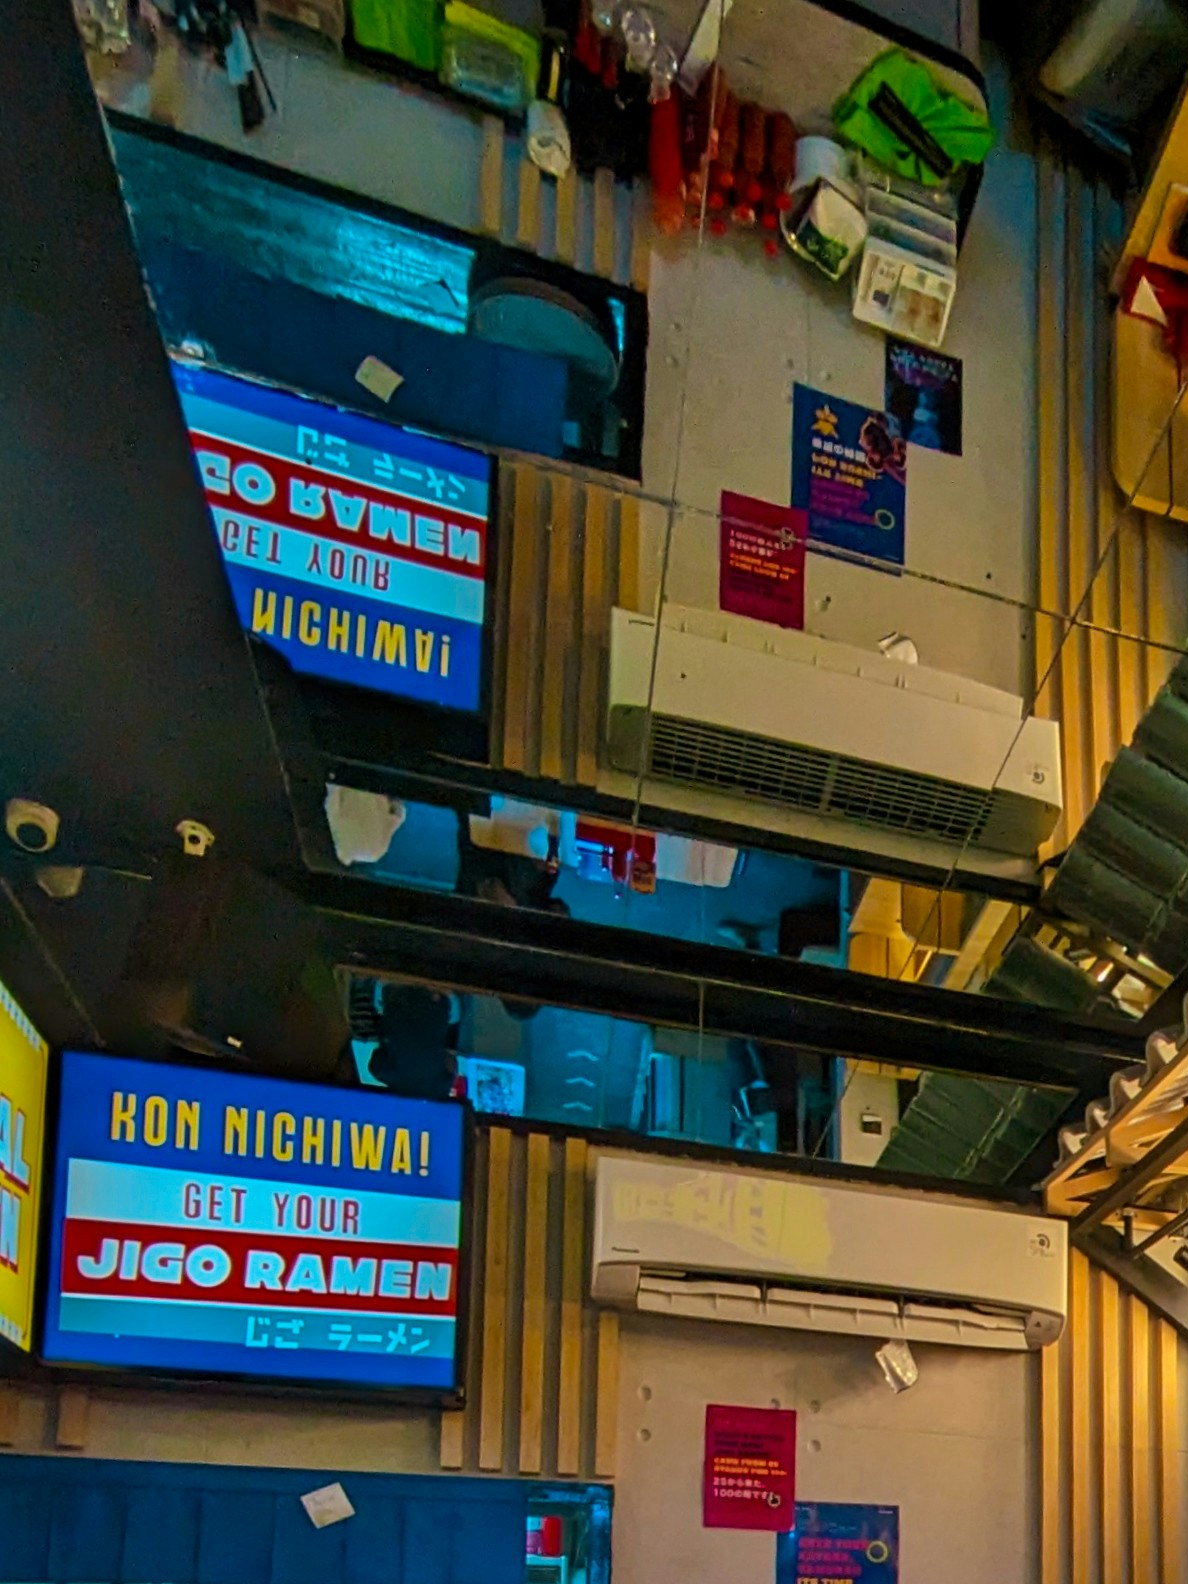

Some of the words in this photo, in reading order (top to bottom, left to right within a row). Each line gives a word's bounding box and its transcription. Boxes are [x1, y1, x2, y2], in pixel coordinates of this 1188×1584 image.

[110, 1091, 201, 1151] KON
[224, 1105, 430, 1177] NICHIWA!
[183, 1182, 247, 1224] GET
[274, 1193, 360, 1235] YOUR
[76, 1238, 232, 1288] JIGO
[244, 1249, 452, 1301] RAMEN
[245, 1316, 305, 1350] じご
[328, 1322, 430, 1354] ラーメン
